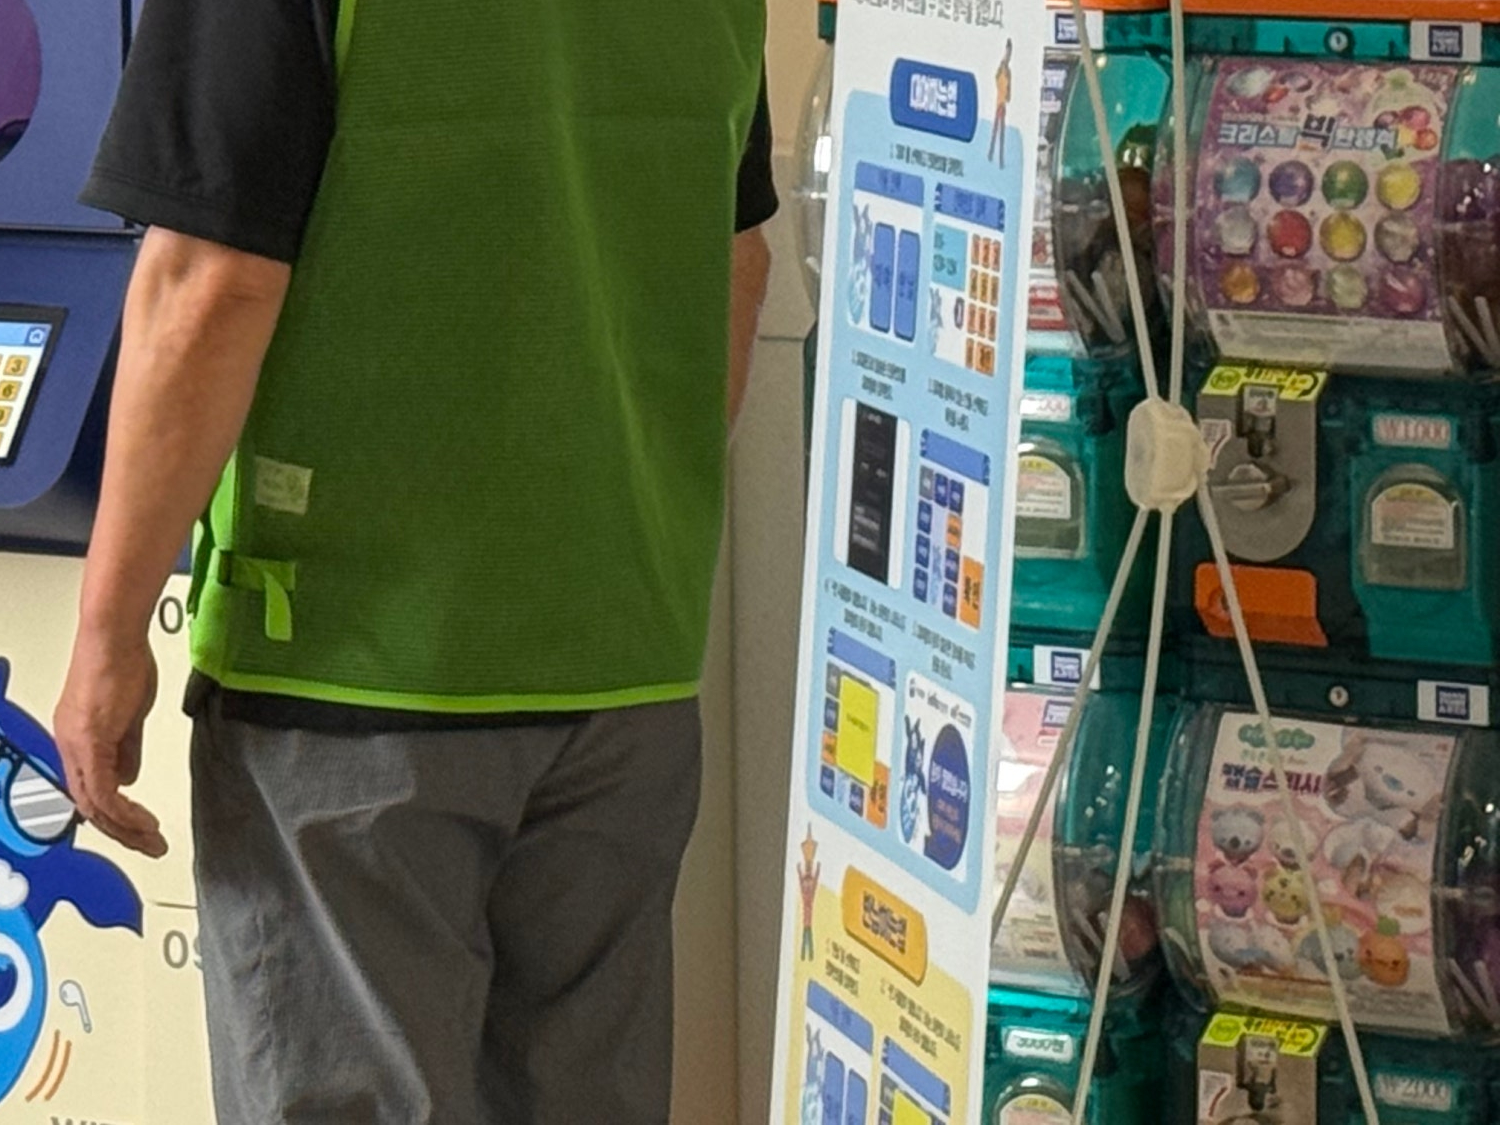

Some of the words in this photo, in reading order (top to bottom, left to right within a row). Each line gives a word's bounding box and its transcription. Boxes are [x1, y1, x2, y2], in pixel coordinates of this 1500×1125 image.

[11, 359, 23, 374] 3
[2, 383, 13, 399] 6
[158, 596, 185, 636] 0
